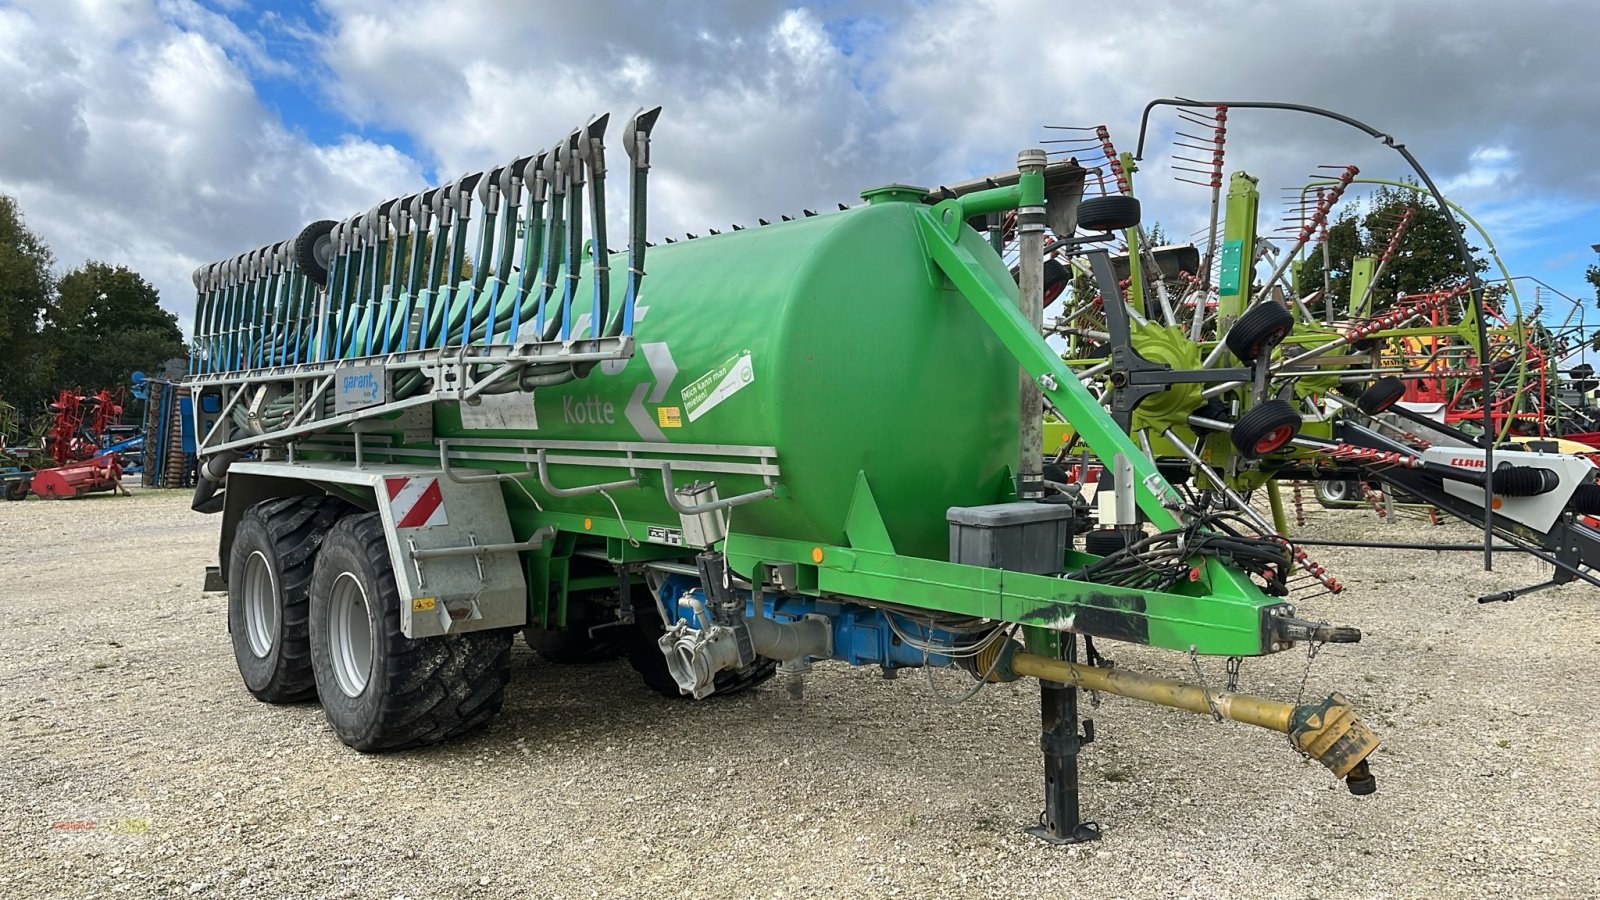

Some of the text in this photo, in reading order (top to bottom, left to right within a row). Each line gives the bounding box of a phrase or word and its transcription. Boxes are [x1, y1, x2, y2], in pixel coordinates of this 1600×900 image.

[343, 372, 373, 393] garant
[683, 385, 698, 400] Mich
[697, 376, 713, 390] kann
[713, 367, 727, 381] man
[686, 388, 708, 408] mieten!
[563, 394, 616, 424] Kotte
[1451, 458, 1486, 468] CLAA
